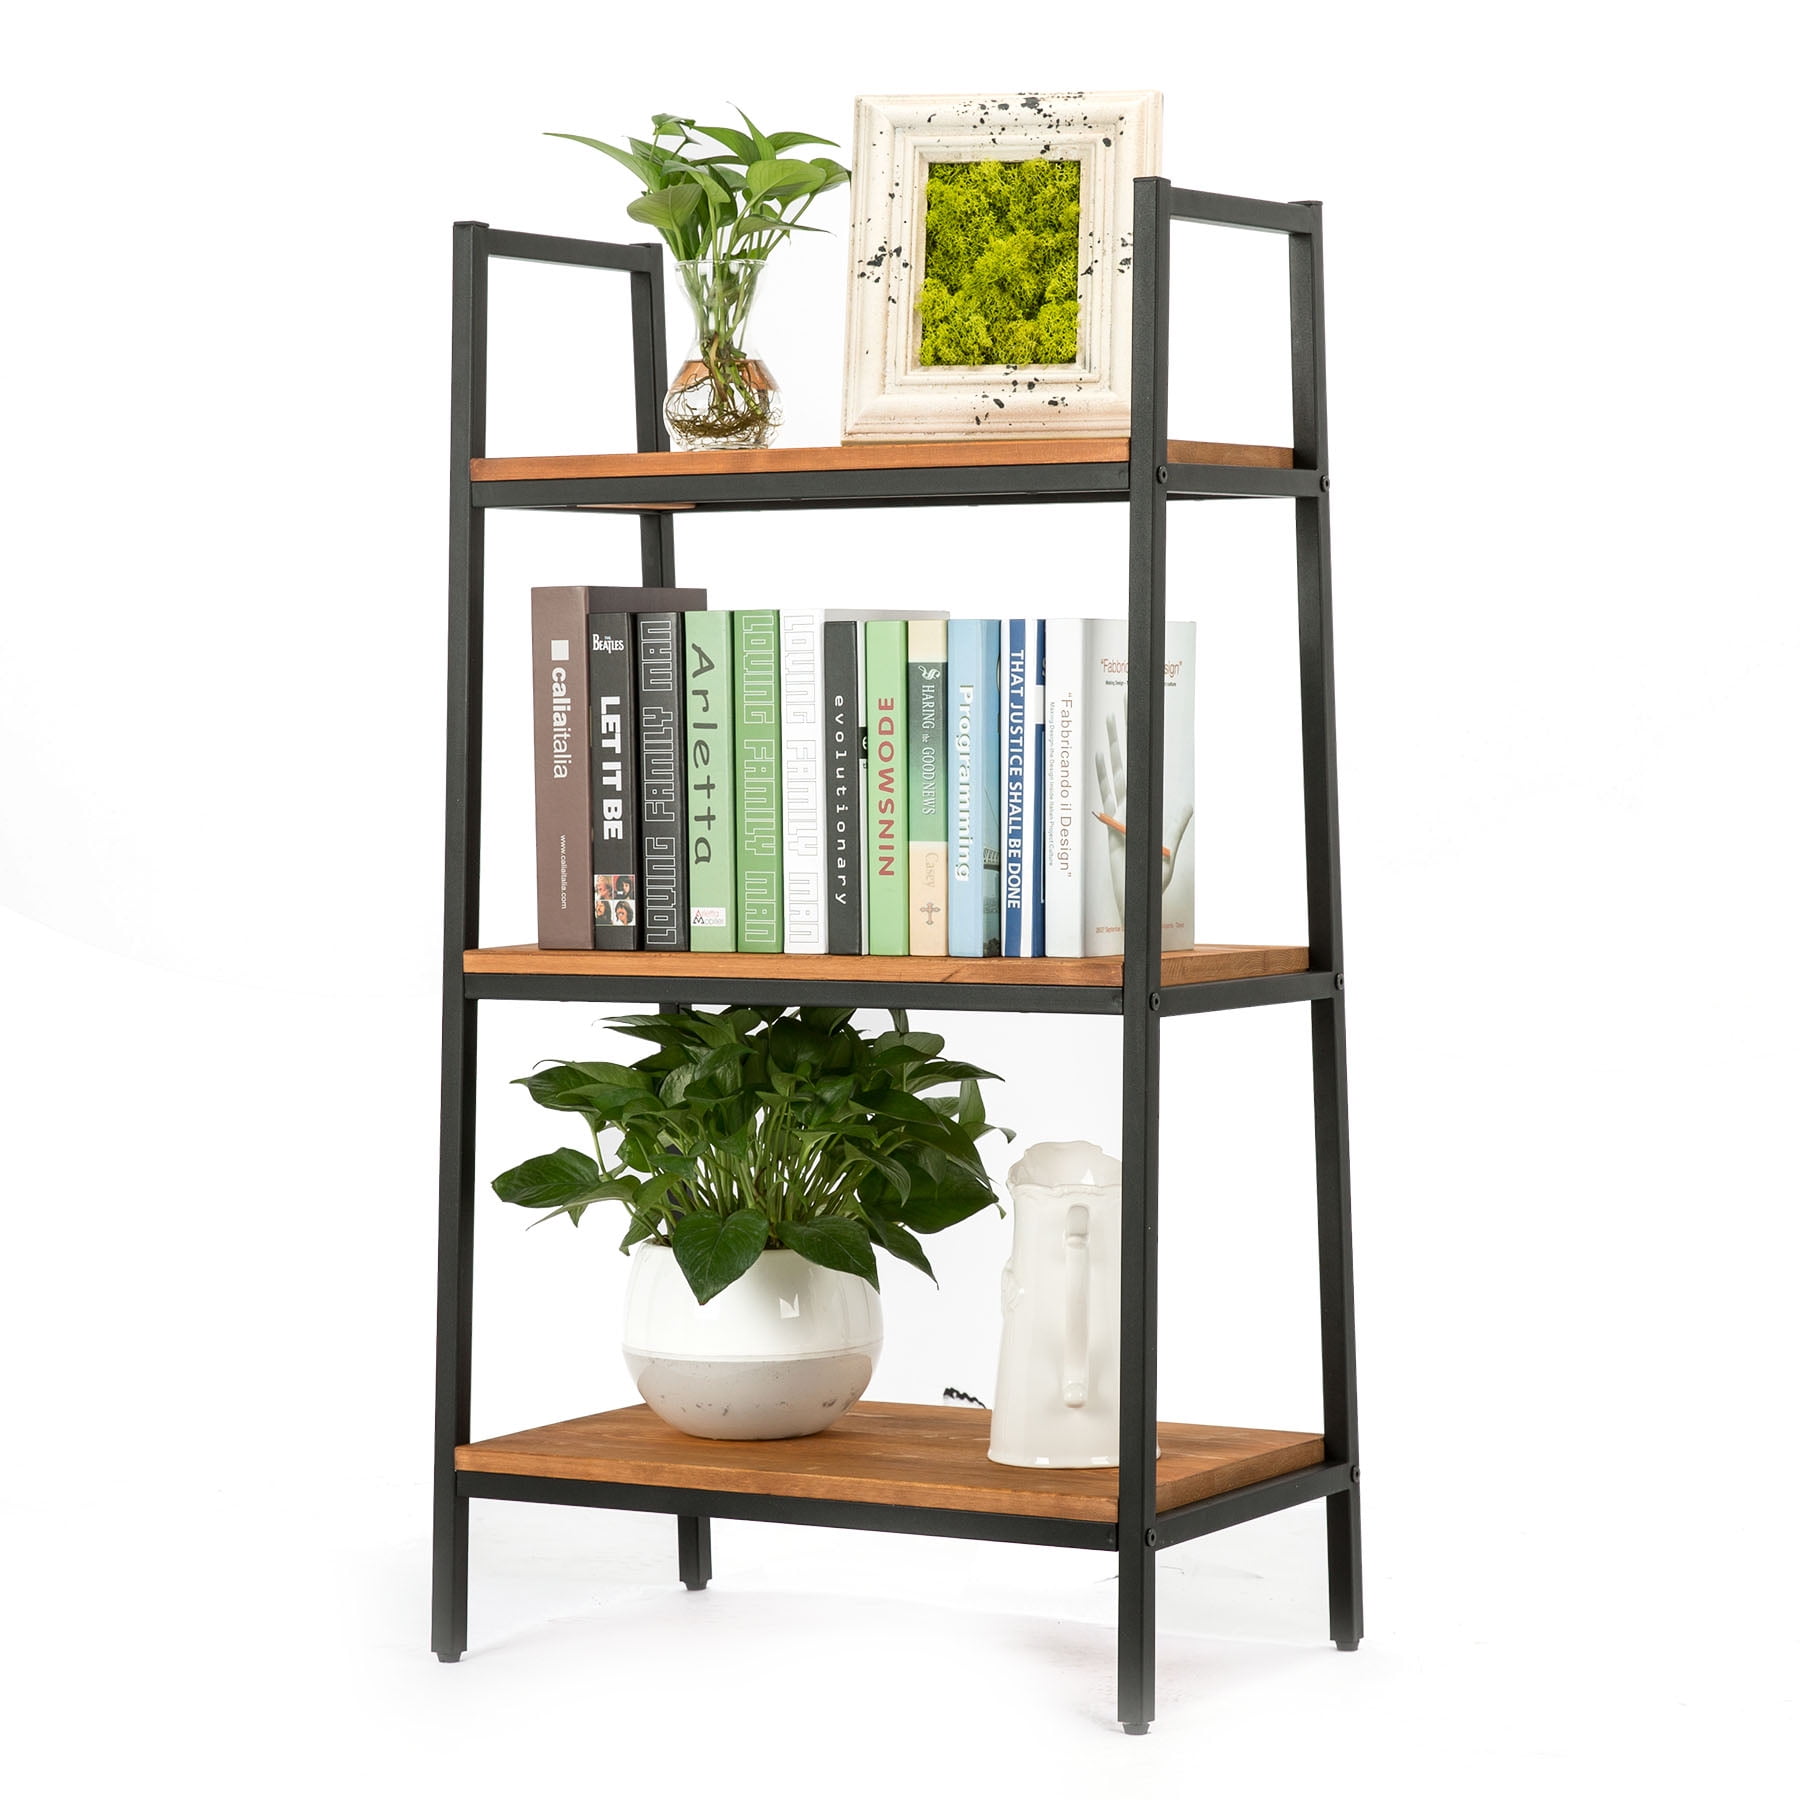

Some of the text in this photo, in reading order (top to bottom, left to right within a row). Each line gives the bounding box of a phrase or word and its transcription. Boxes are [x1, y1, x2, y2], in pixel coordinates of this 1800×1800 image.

[551, 666, 572, 779] caliaitalia
[592, 633, 625, 654] BEATLES
[600, 696, 623, 840] LET IT BE
[640, 620, 677, 945] LOVING FAMILY MAN
[691, 643, 718, 865] Arletta
[742, 615, 777, 943] LOVING FAMILY MAN
[784, 615, 820, 943] LOVING FAMILY MAN
[834, 695, 849, 905] evolutionary
[878, 697, 895, 876] NINSMODE
[921, 733, 929, 743] the
[921, 747, 936, 780] GOOD
[921, 782, 937, 816] NEWS
[954, 685, 974, 882] Programming
[1007, 649, 1025, 909] THAT JUSTICE SHALL BE DONE
[1060, 802, 1073, 811] il
[923, 852, 938, 888] Casey
